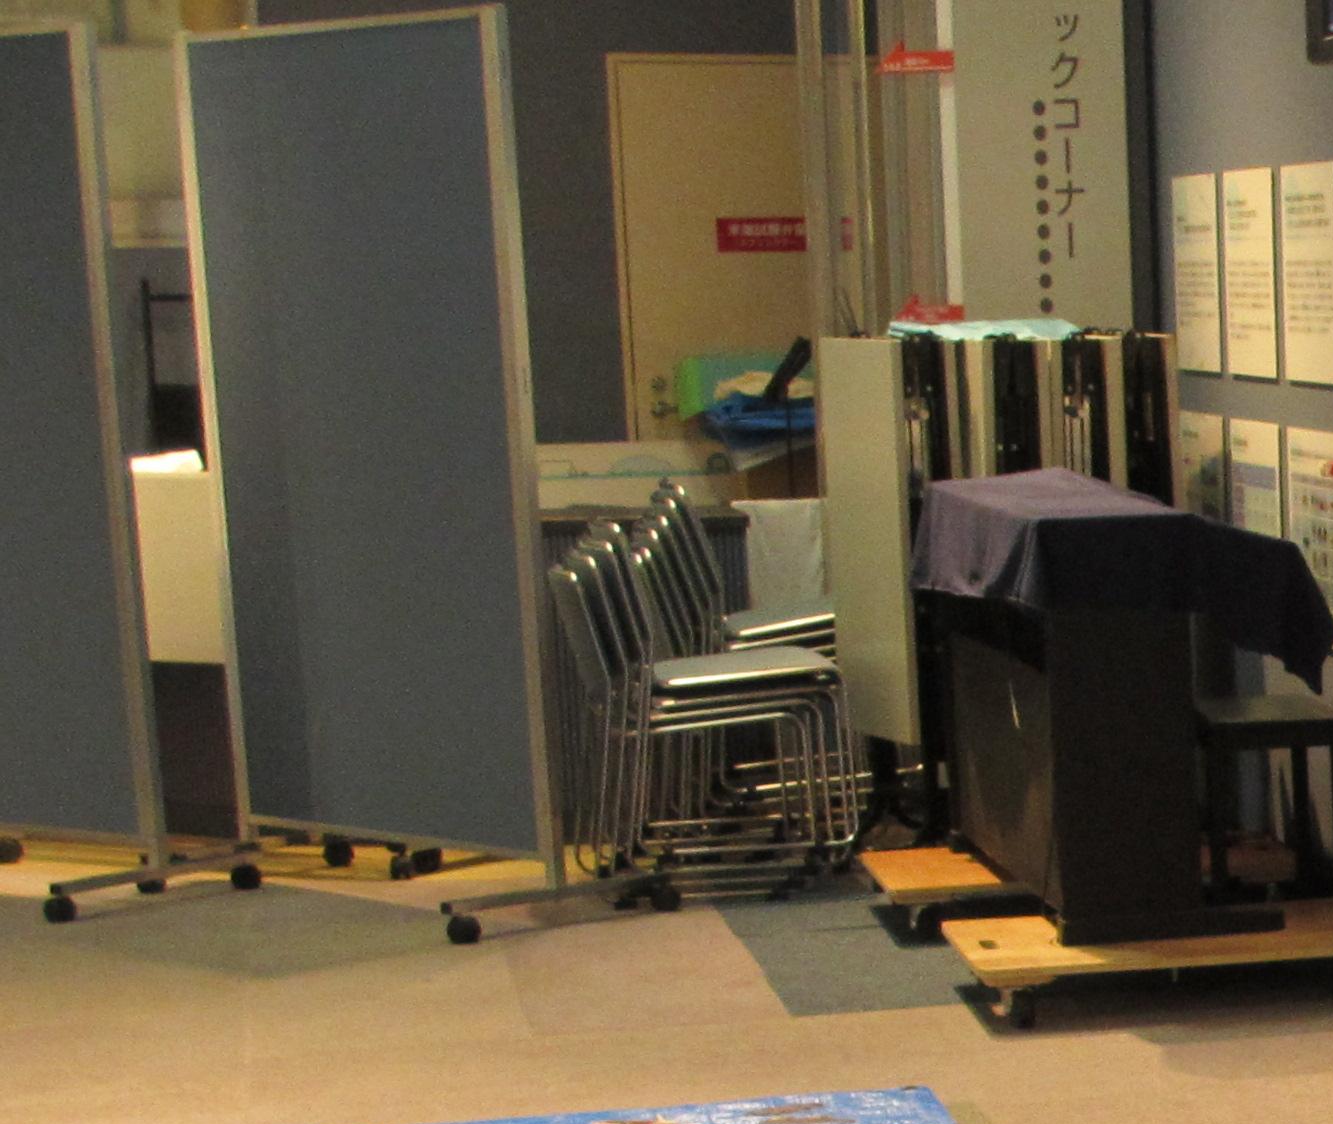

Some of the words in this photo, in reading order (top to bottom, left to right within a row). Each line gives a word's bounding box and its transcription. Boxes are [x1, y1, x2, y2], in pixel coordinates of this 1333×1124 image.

[1050, 13, 1085, 259] ックコーナー
